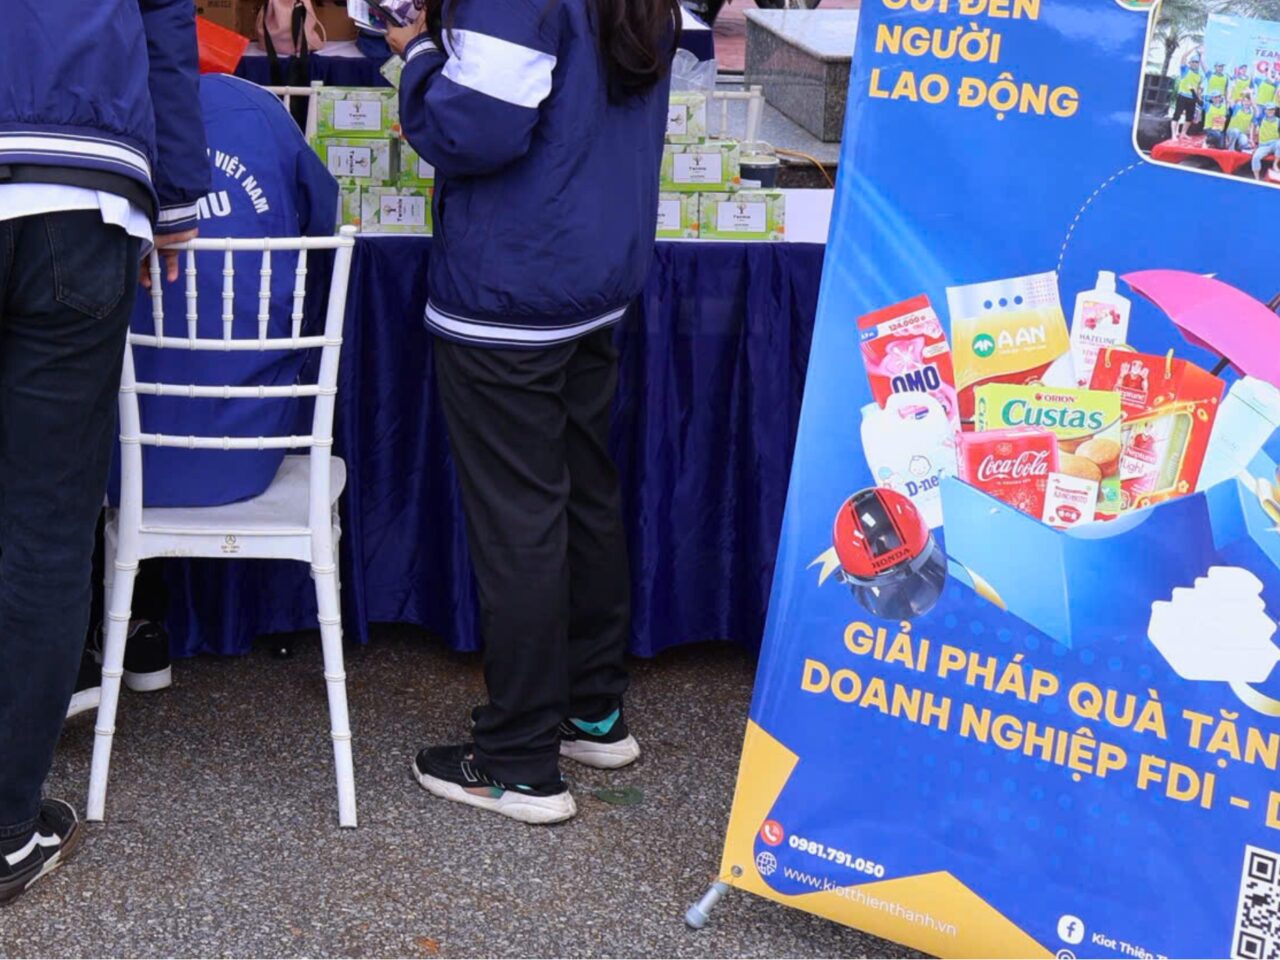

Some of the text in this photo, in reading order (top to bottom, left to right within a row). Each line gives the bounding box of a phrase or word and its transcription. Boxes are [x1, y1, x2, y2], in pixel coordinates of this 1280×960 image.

[874, 19, 1002, 64] NGƯỜI
[868, 68, 1080, 121] LAO ĐỘNG
[214, 149, 270, 214] VIỆT NAM
[891, 365, 941, 394] OMO
[1044, 395, 1075, 404] ORION
[1001, 399, 1104, 430] Custas
[977, 449, 1051, 483] Coca-Cola
[871, 547, 911, 569] HONDA
[842, 619, 930, 674] GIẢI
[938, 645, 1059, 712] PHÁP
[1068, 680, 1170, 737] QUÀ
[800, 657, 1217, 809] DOANH NGHIỆP FDI
[787, 834, 886, 879] 0981.791.050
[782, 865, 958, 937] www.kiotthienthanh.vn
[1091, 932, 1117, 951] Kiot
